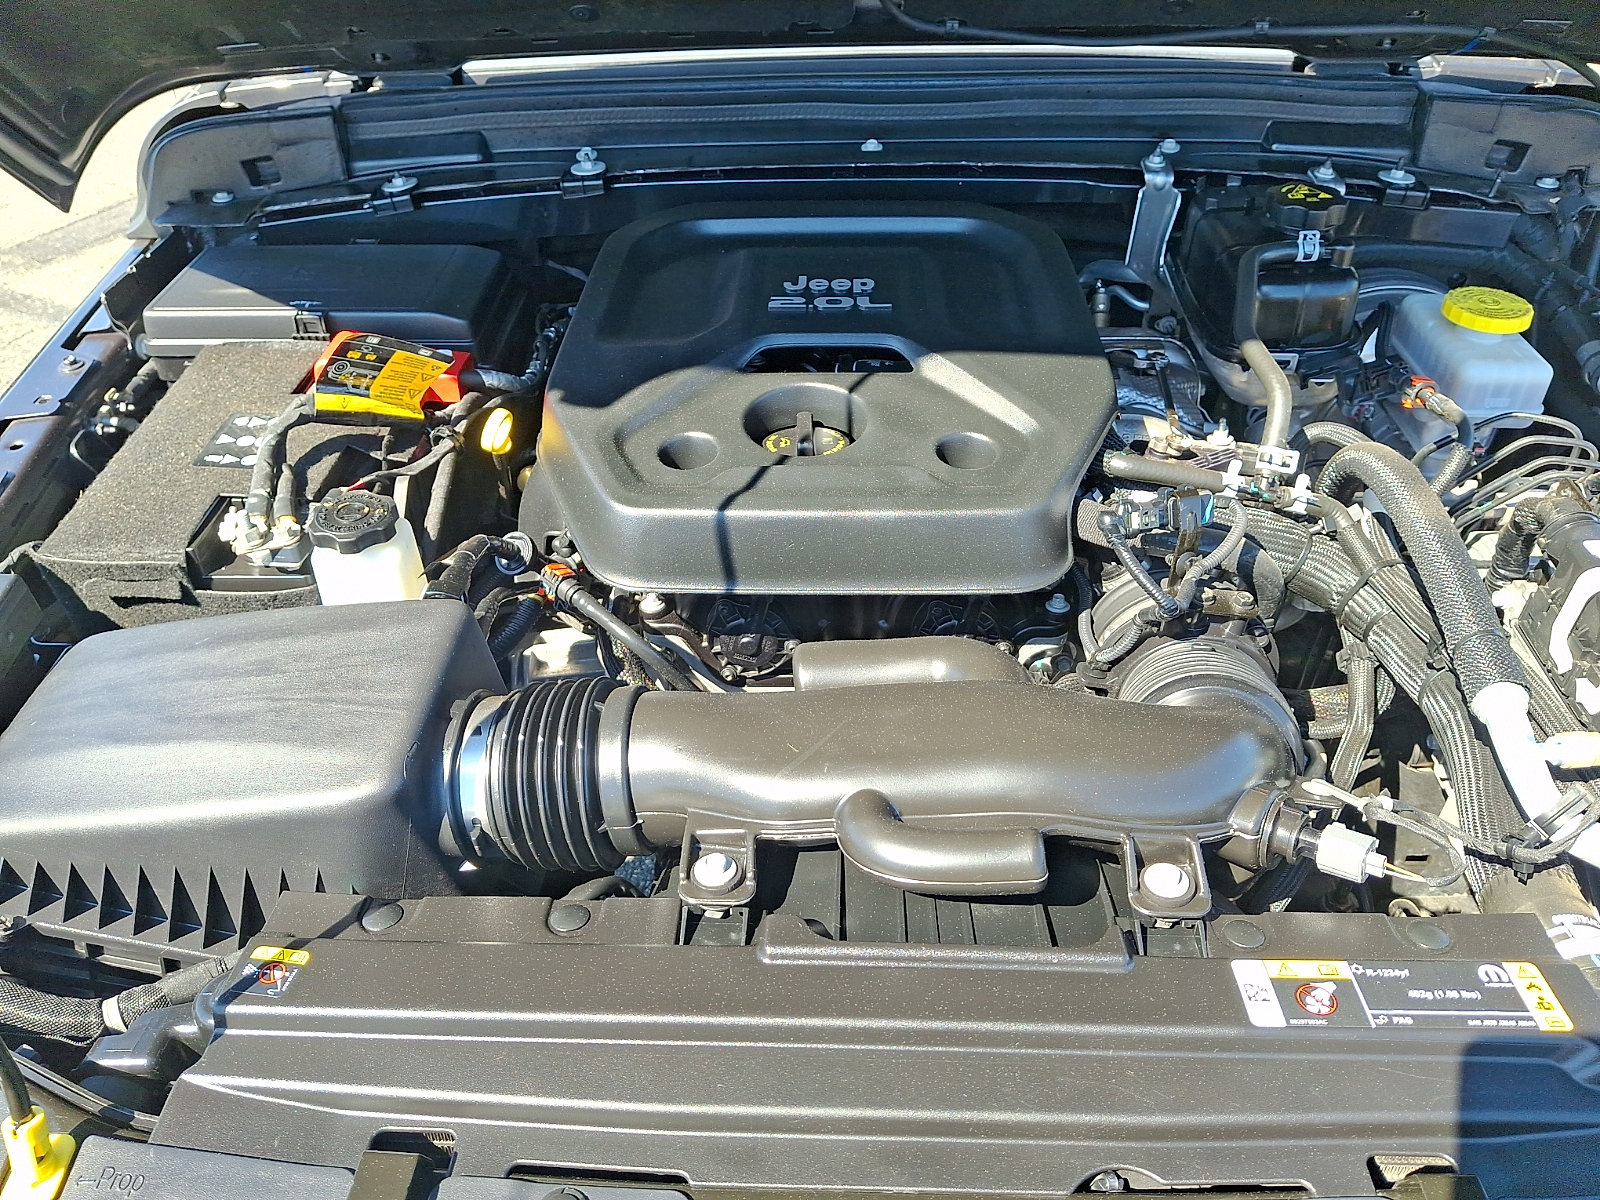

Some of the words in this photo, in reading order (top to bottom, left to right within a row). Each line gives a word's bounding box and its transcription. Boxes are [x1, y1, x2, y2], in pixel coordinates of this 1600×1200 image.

[783, 275, 875, 293] Jeep
[767, 296, 893, 311] 2.0L
[96, 1166, 145, 1197] Prop
